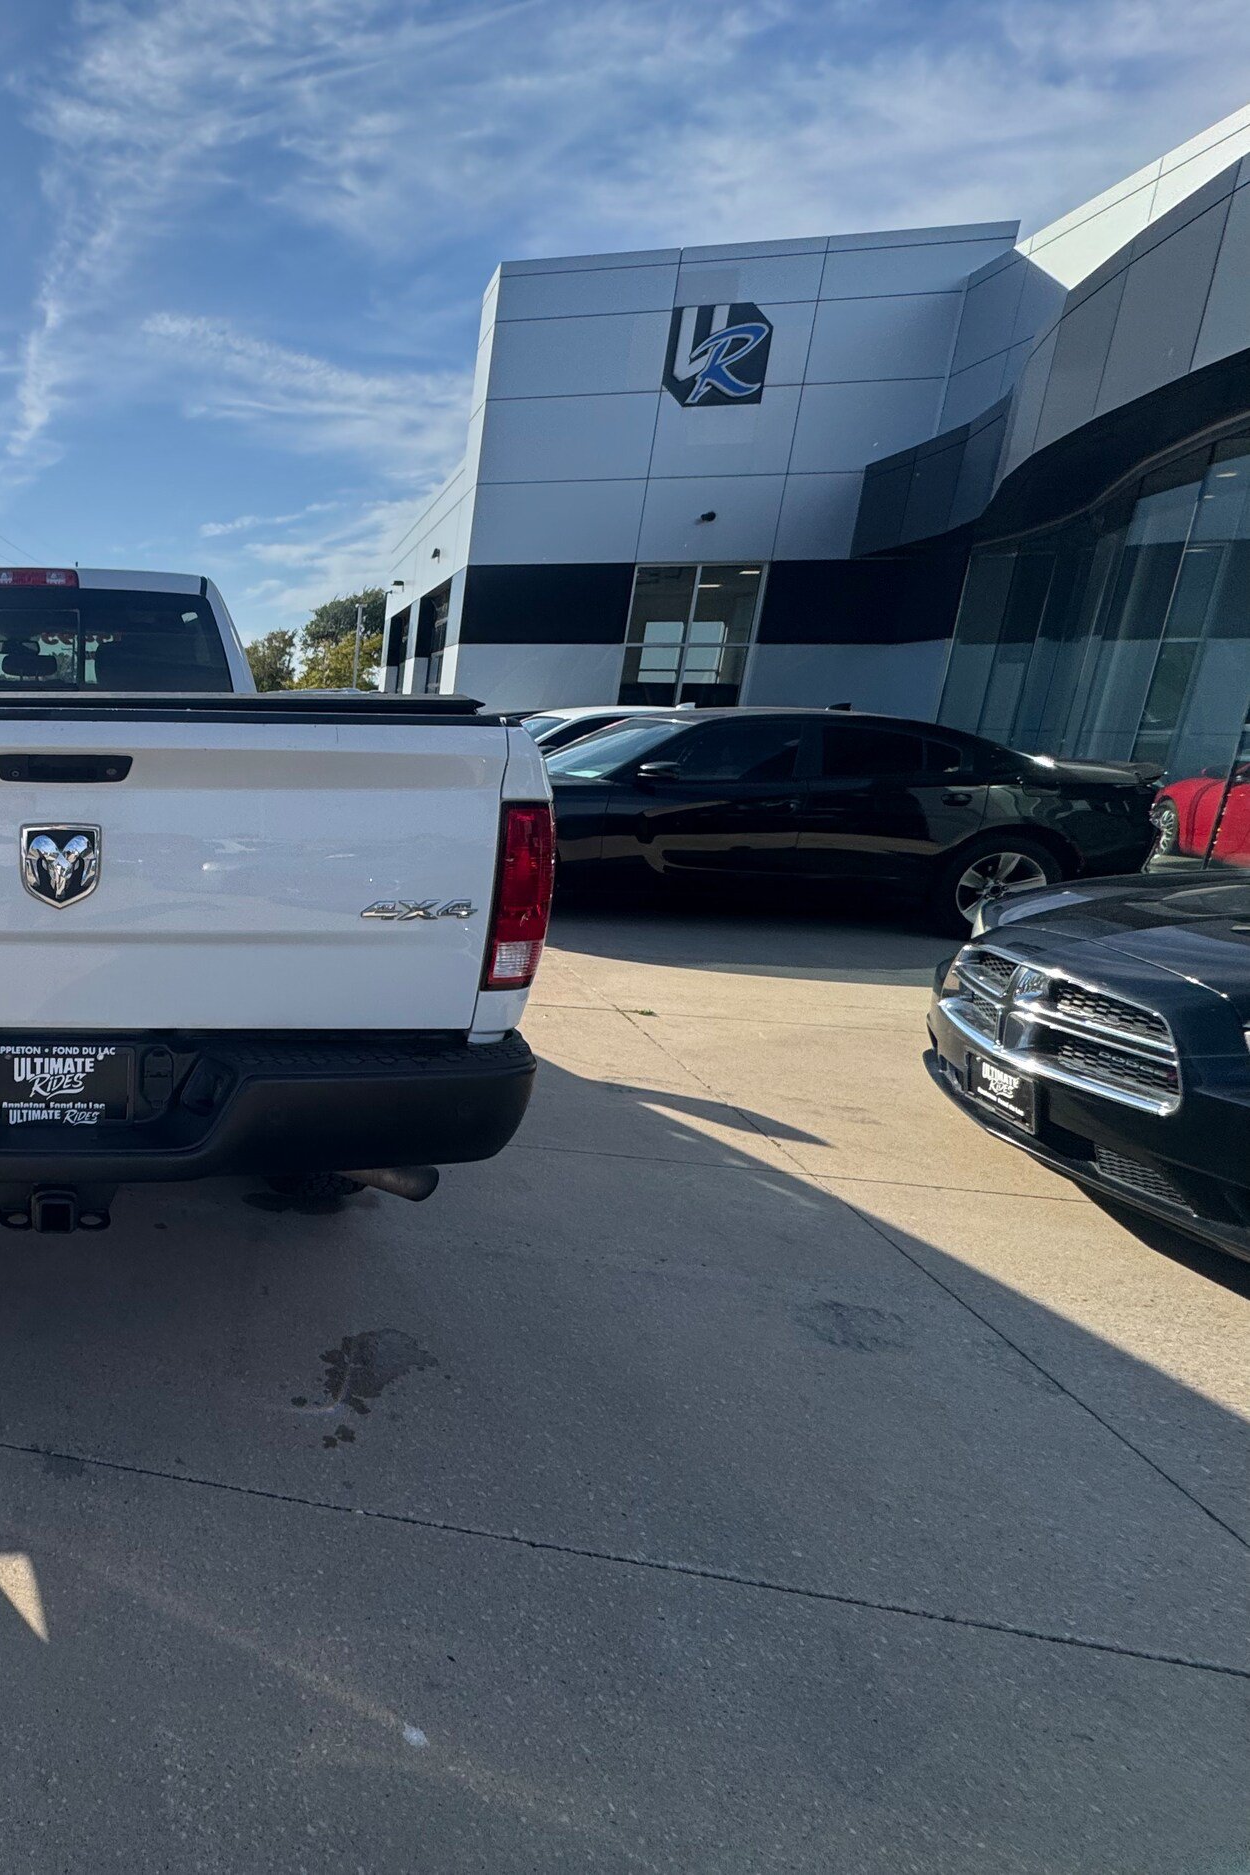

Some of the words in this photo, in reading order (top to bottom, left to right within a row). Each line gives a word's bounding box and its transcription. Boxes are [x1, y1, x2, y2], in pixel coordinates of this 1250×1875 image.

[360, 899, 479, 920] 4X4
[52, 1046, 80, 1055] FOND
[82, 1046, 96, 1055] DU
[98, 1046, 116, 1056] LAC
[13, 1057, 95, 1082] ULTIMATE
[982, 1062, 1020, 1089] ULTIMATE
[28, 1072, 87, 1100] RIDES
[8, 1109, 61, 1125] ULTIMATE
[62, 1109, 100, 1126] RIDES
